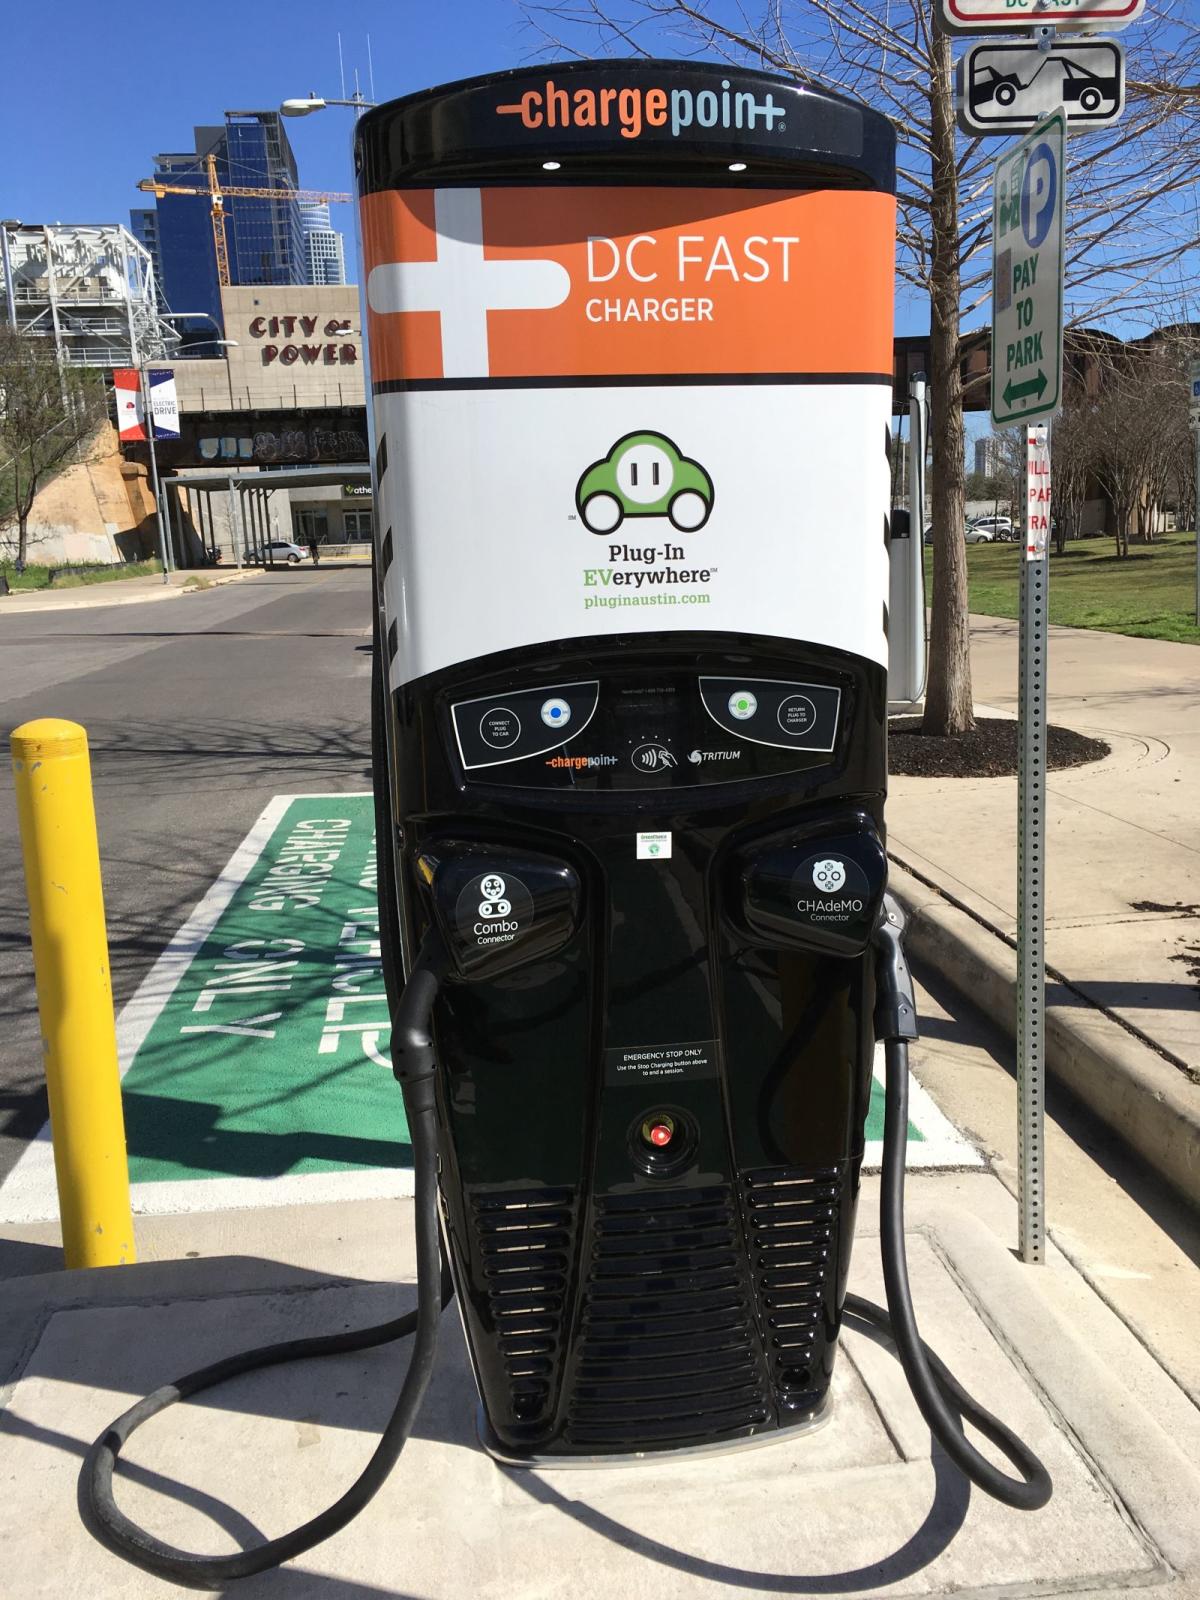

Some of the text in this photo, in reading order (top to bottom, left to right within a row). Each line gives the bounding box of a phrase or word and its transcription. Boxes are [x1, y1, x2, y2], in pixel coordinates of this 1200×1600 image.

[586, 235, 800, 283] DC FAST
[1013, 253, 1040, 294] PAY
[585, 298, 714, 322] CHARGER
[1016, 296, 1033, 330] TO
[250, 315, 318, 337] CITY
[263, 343, 358, 365] POWER
[1006, 331, 1043, 373] PARK
[154, 406, 177, 415] DRIVE
[1028, 461, 1050, 475] ILL
[1028, 515, 1048, 530] RA
[608, 543, 685, 564] Plug-In
[583, 567, 711, 588] EVerywhere
[584, 593, 711, 609] pluginaustin.com
[701, 750, 741, 761] TRITIUM
[797, 899, 863, 912] CHAdeMO
[810, 913, 850, 921] Connector
[473, 919, 519, 935] Combo
[477, 934, 515, 945] Connector
[180, 938, 307, 1039] ONLY
[623, 1048, 702, 1061] EMERGENCY STOP ONLY
[650, 1061, 674, 1069] Charging
